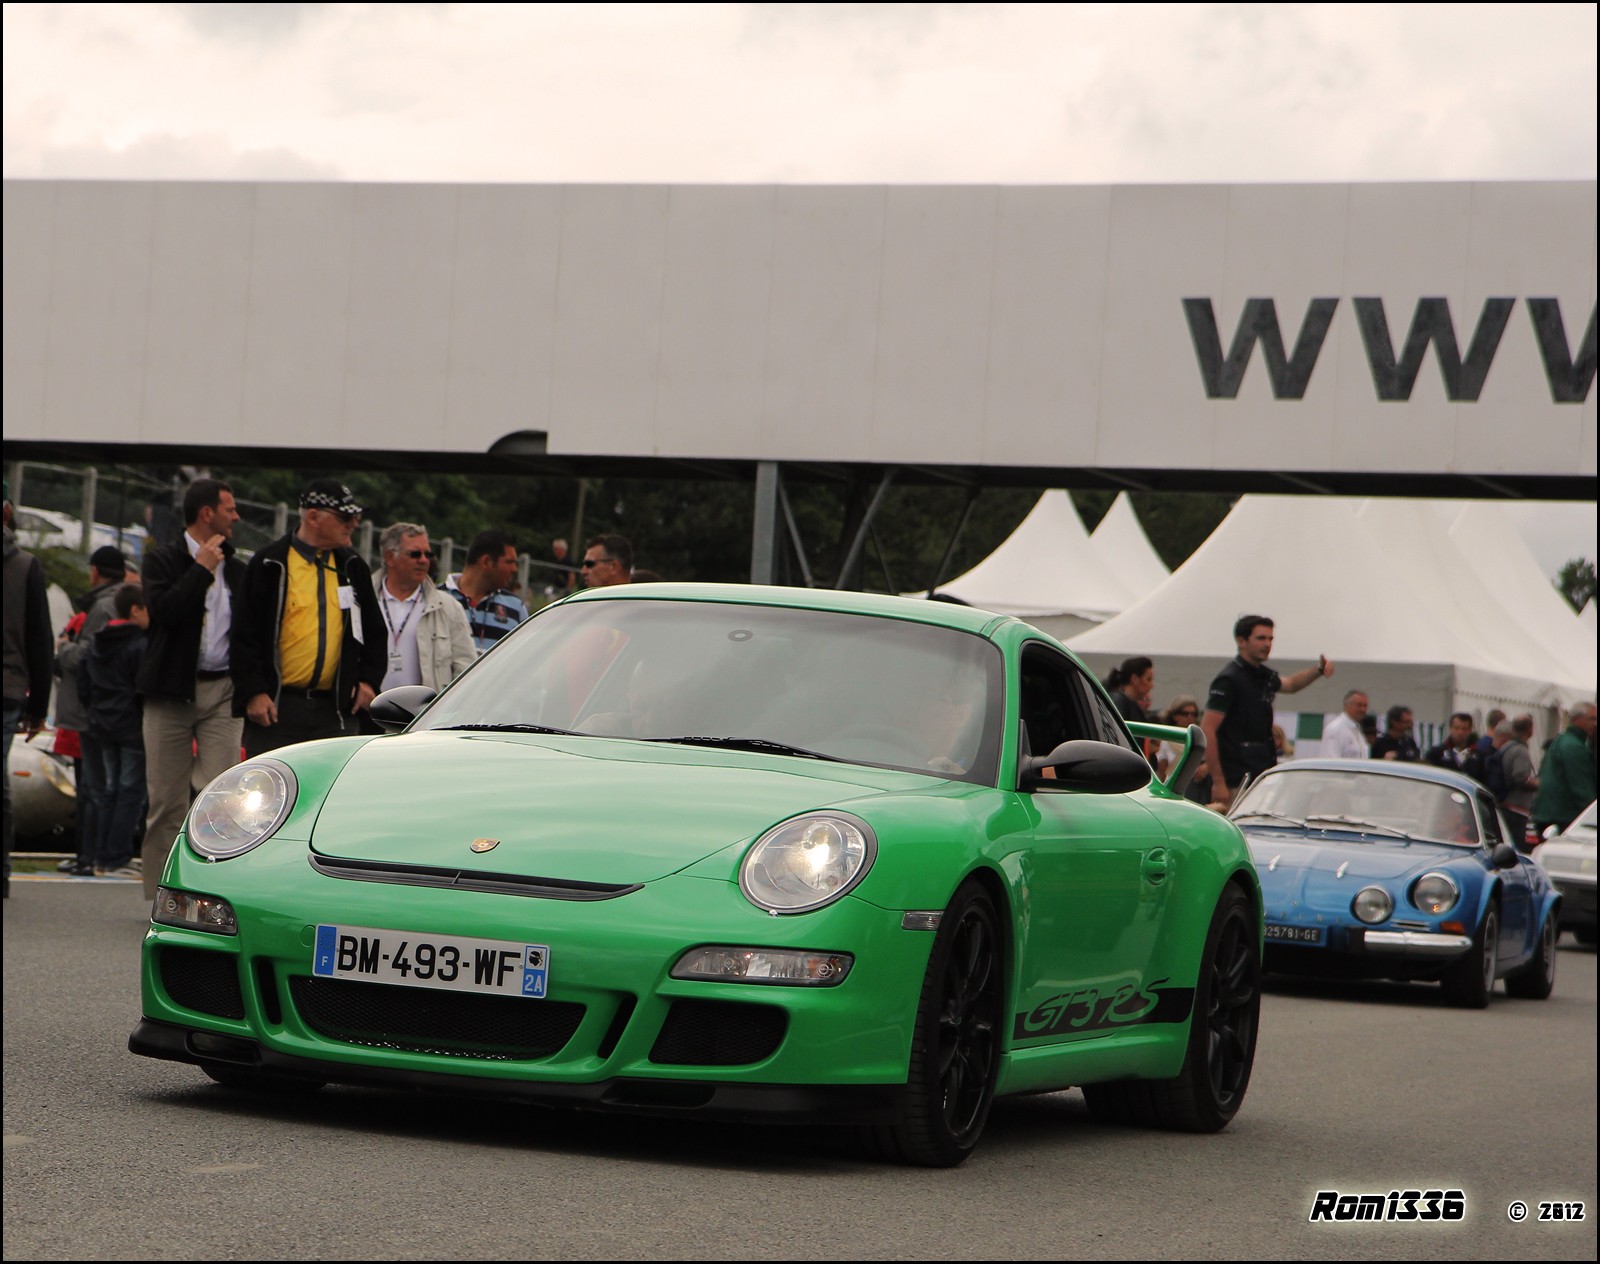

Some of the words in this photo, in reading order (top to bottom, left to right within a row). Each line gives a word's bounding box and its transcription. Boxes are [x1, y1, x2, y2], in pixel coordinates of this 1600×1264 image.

[321, 955, 329, 967] F
[337, 935, 521, 987] BM-493-WF
[524, 974, 544, 993] 2A
[1023, 988, 1100, 1032] GT3
[1098, 976, 1170, 1025] RS
